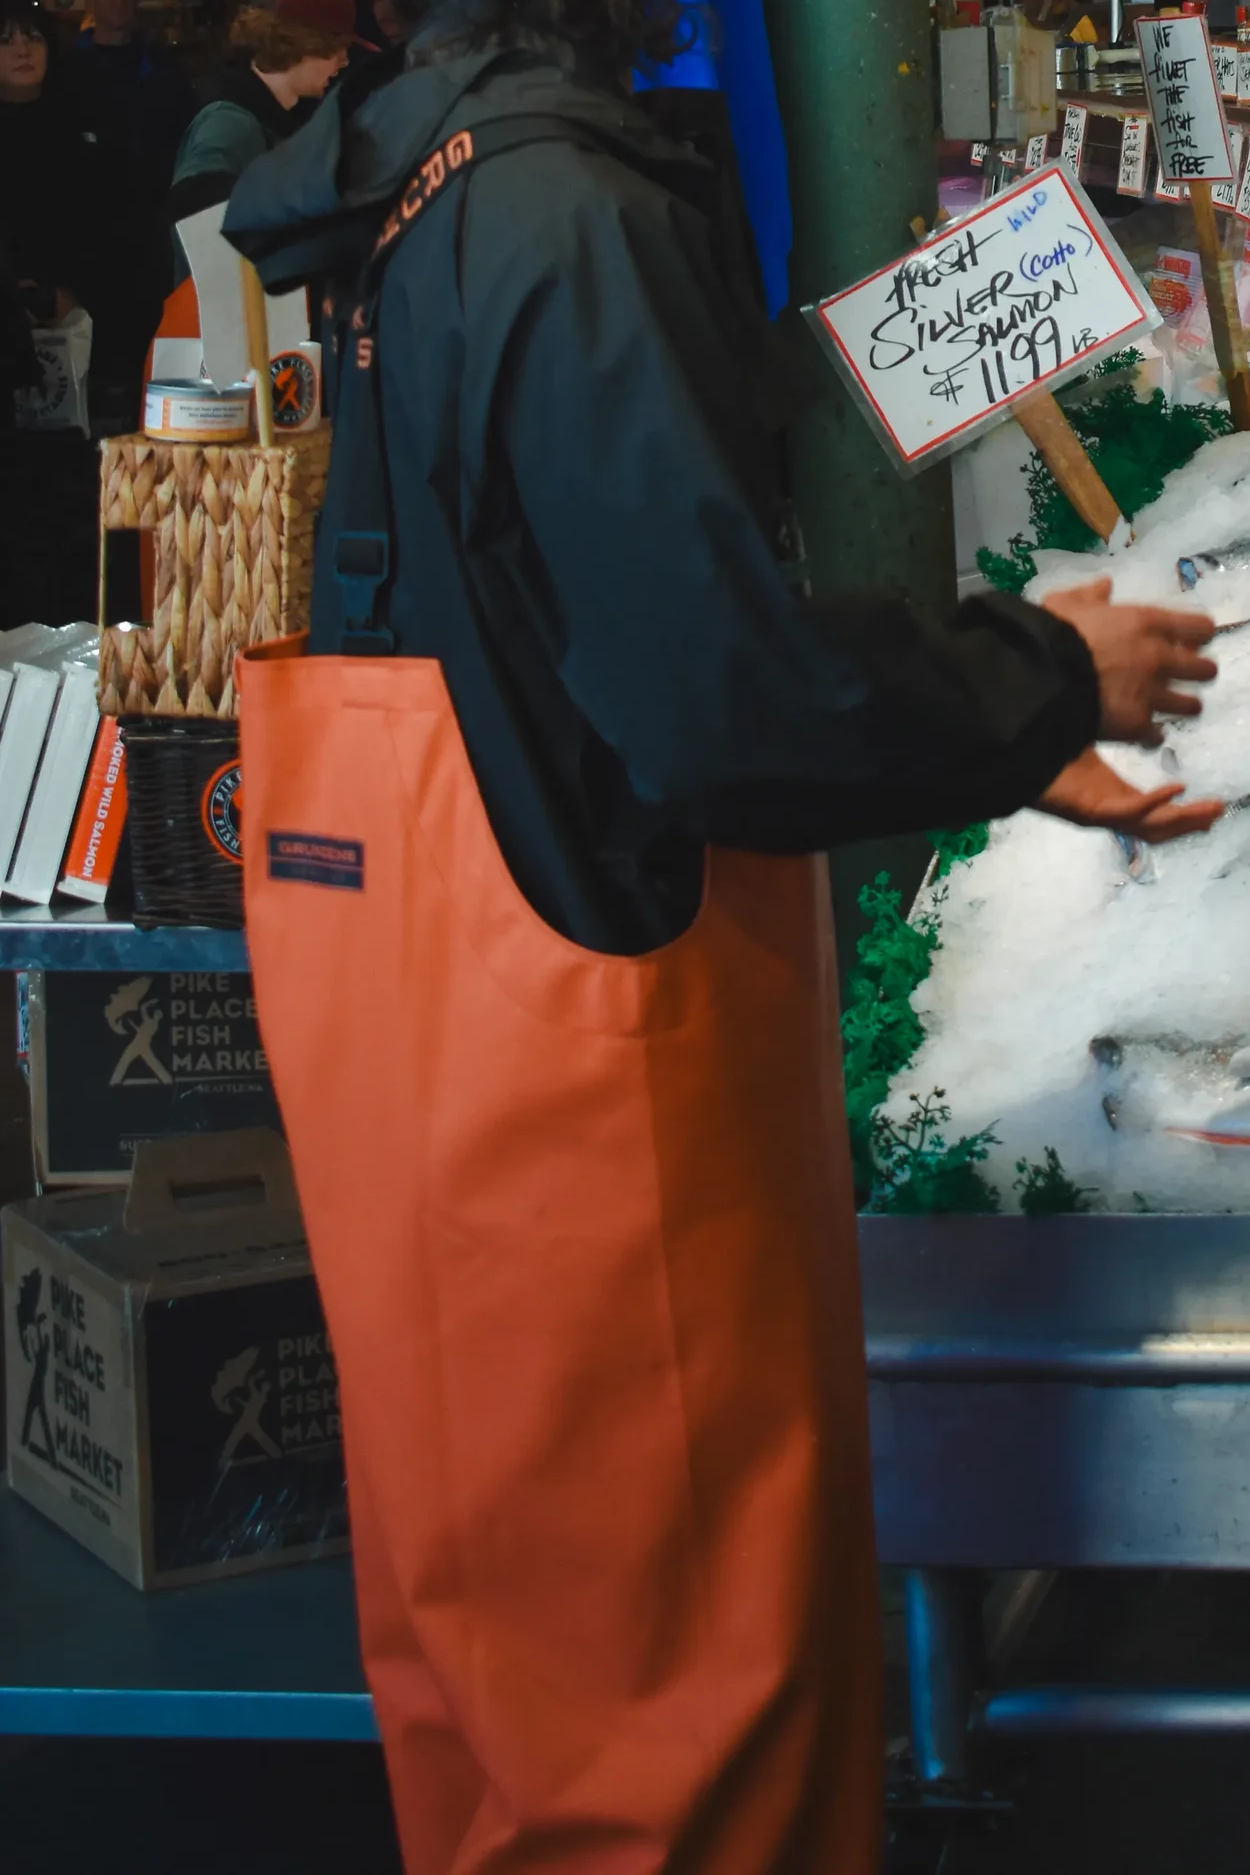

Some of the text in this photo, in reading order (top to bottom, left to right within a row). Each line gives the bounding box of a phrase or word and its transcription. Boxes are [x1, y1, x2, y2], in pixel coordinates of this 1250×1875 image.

[1153, 25, 1173, 52] WE
[1157, 85, 1190, 105] THE
[1169, 153, 1214, 178] FREE
[1007, 190, 1048, 233] WILD
[870, 271, 1030, 369] SILVER
[923, 263, 1078, 375] SALMON
[97, 786, 116, 820] WILD
[82, 818, 108, 879] SALMON
[170, 973, 230, 993] PIKE
[171, 998, 258, 1020] PLACE
[172, 1025, 231, 1046] FISH
[172, 1050, 269, 1072] MARKE
[50, 1276, 86, 1332] PIKE
[52, 1322, 106, 1393] PLACE
[279, 1366, 340, 1390] PLA
[54, 1370, 90, 1428] FISH
[281, 1415, 344, 1447] MAR
[55, 1419, 123, 1497] MARKET
